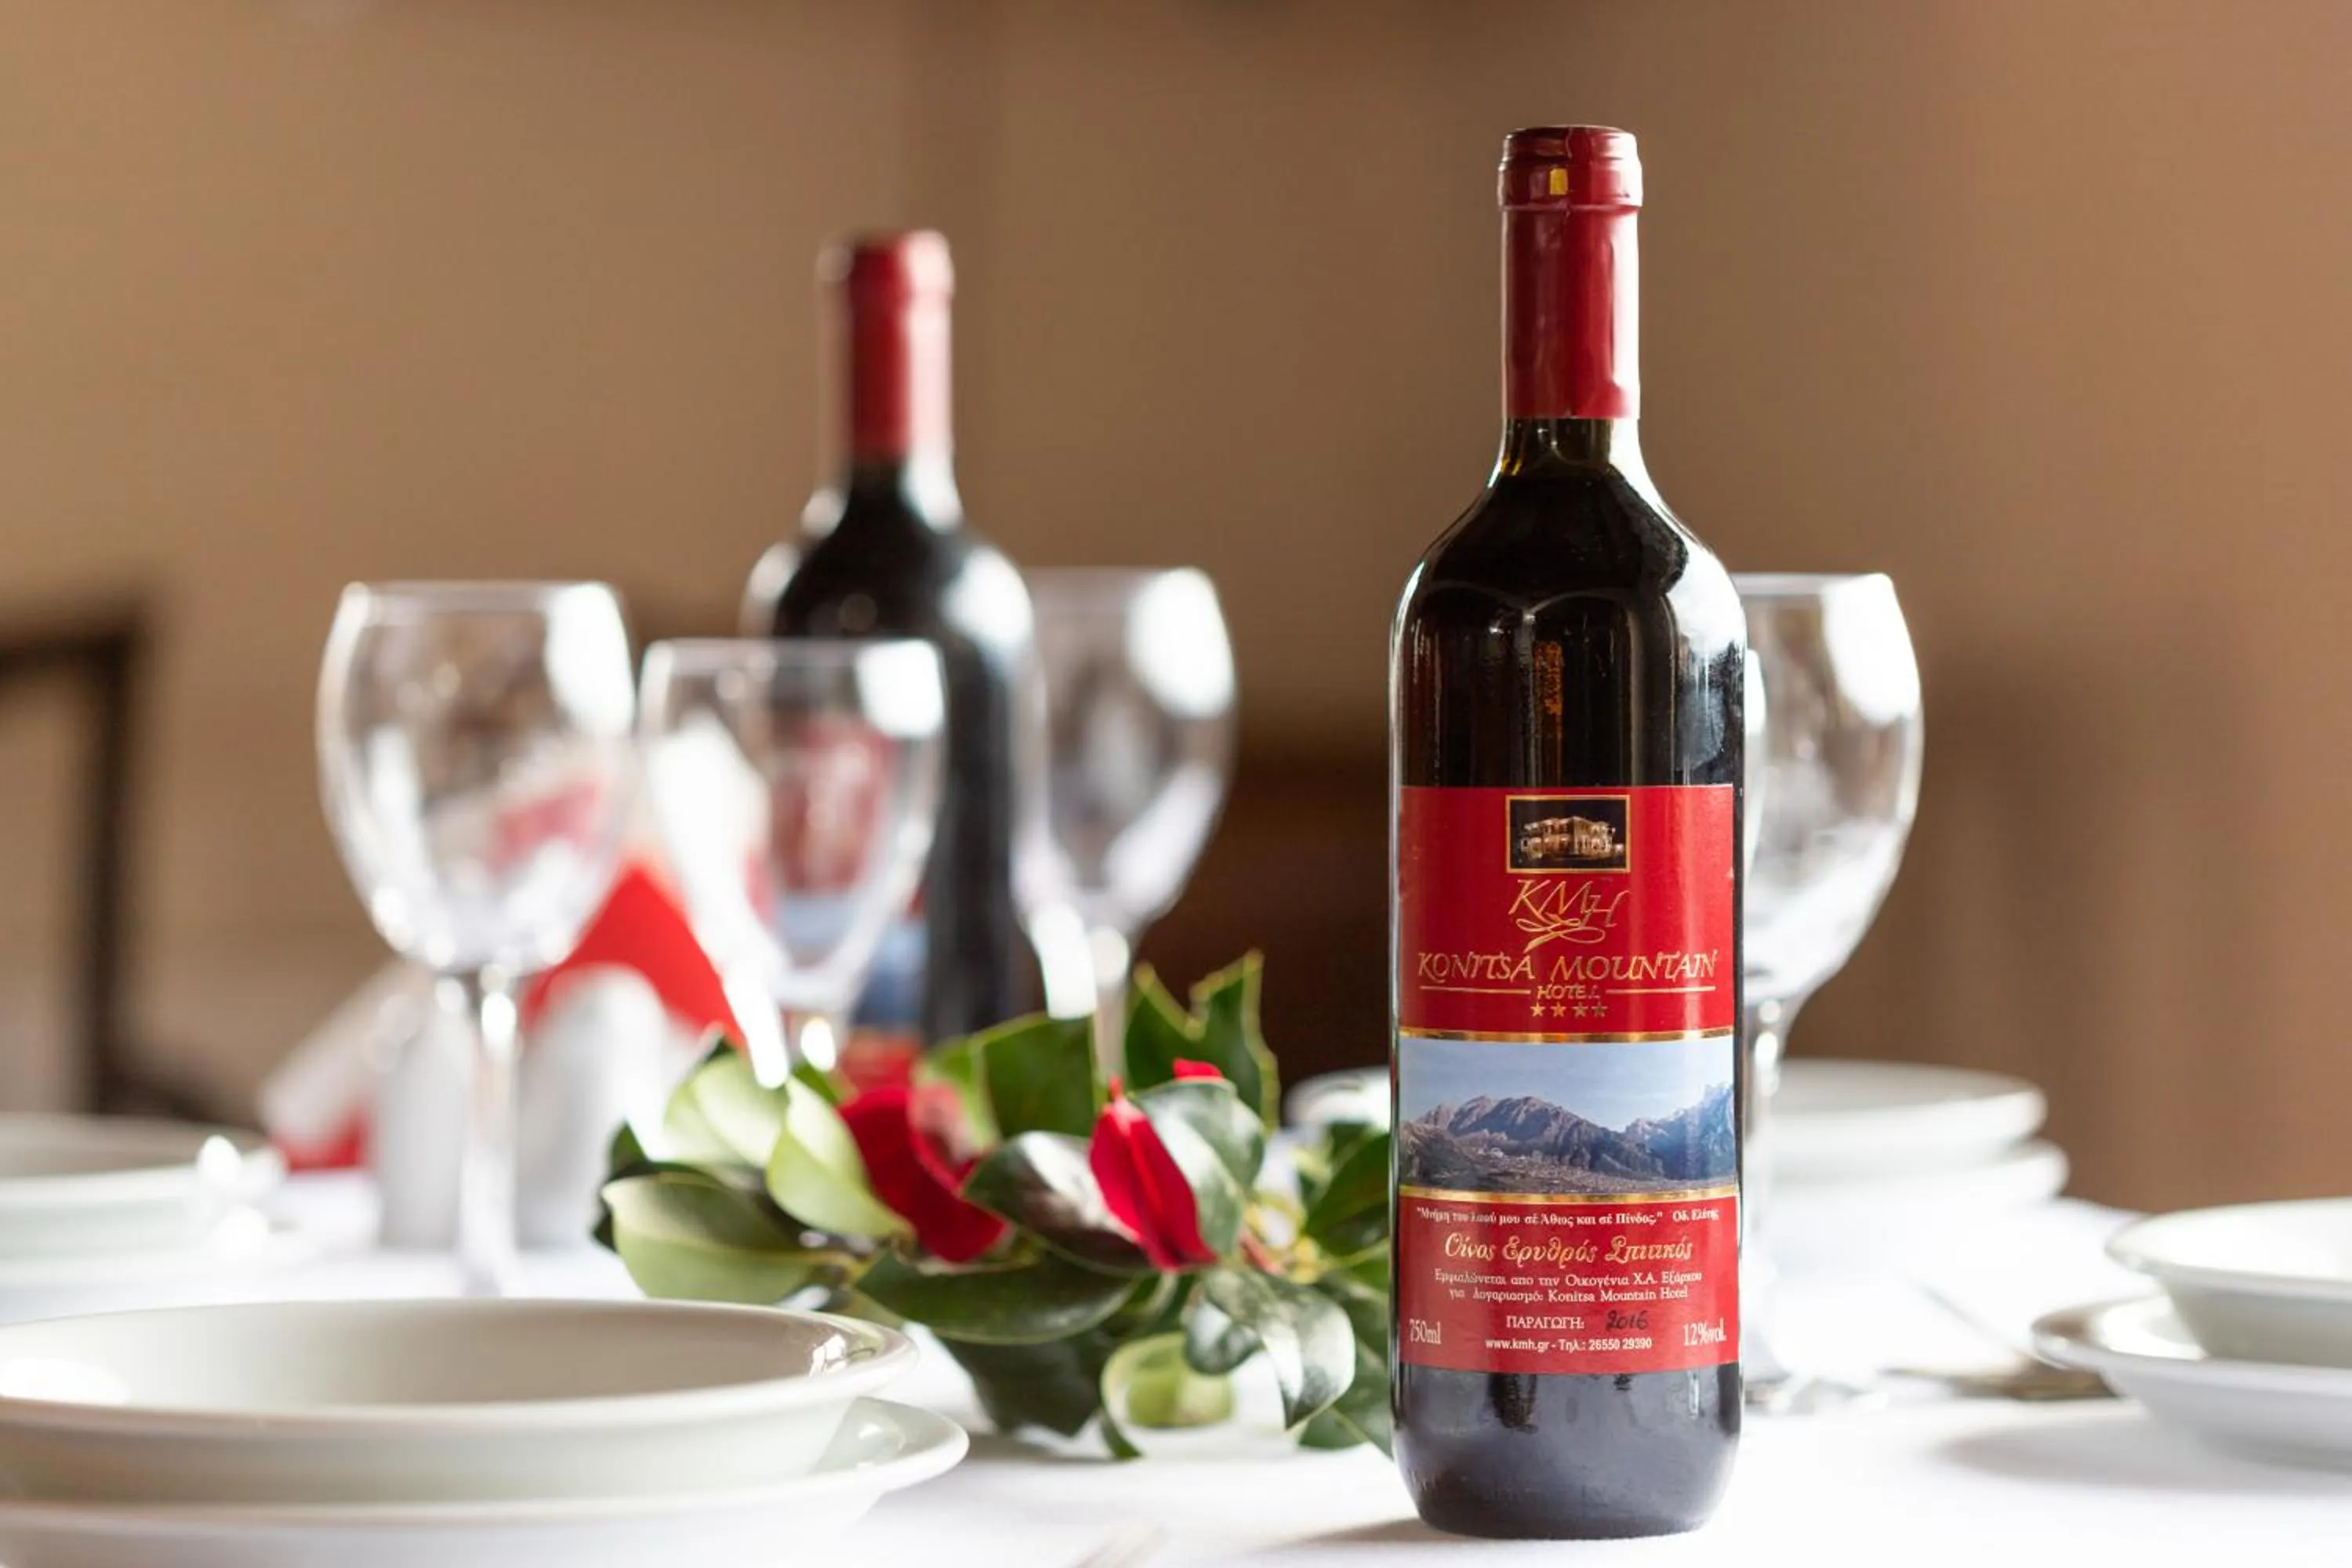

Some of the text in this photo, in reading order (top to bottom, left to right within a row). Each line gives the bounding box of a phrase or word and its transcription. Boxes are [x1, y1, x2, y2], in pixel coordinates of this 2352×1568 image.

[1417, 949, 1718, 983] KONITSA MOUNTAIN
[1536, 984, 1601, 1000] HOTEL
[1499, 1214, 1520, 1225] μου
[1577, 1216, 1596, 1225] και
[1538, 1276, 1560, 1287] την
[1548, 1290, 1595, 1302] Konitsa
[1600, 1289, 1657, 1301] Mountain
[1660, 1285, 1689, 1299] Hotel
[1506, 1315, 1584, 1330] ΠΑΡΑΓΩΓΗ:
[1606, 1309, 1649, 1330] 2016
[1409, 1319, 1441, 1345] 750ml
[1485, 1338, 1550, 1352] www.kmh.gr
[1589, 1338, 1620, 1350] 26550
[1622, 1338, 1653, 1349] 29390
